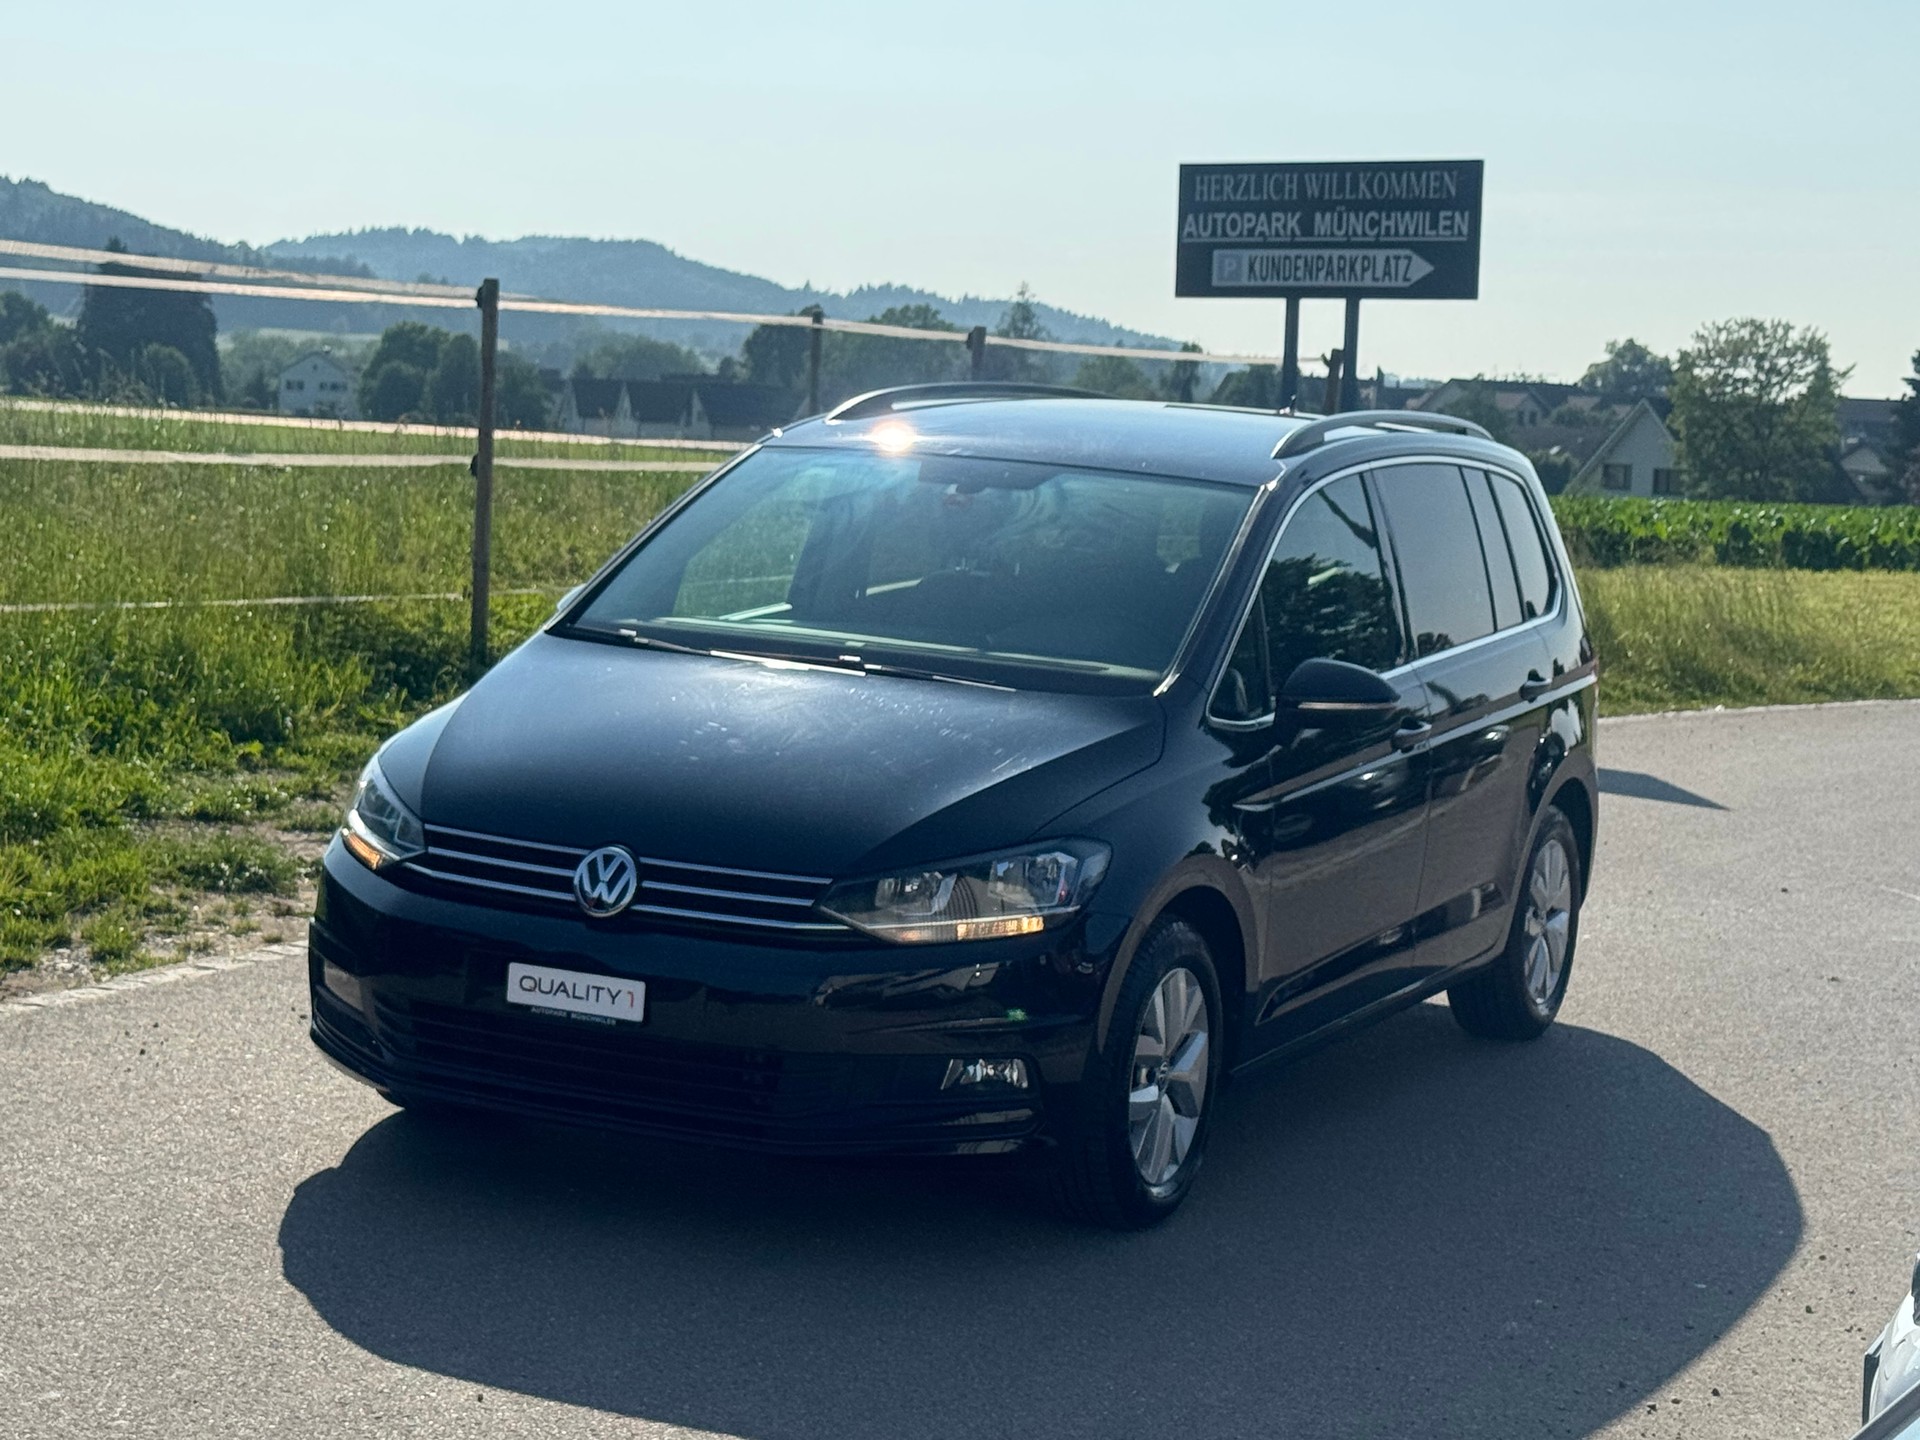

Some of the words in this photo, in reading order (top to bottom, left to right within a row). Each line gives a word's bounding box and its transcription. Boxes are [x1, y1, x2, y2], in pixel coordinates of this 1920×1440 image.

[1195, 173, 1298, 201] HERZLICH
[1304, 170, 1458, 200] WILLKOMMEN
[1182, 212, 1301, 237] AUTOPARK
[1314, 206, 1470, 236] MÜNCHWILEN
[1247, 254, 1413, 283] KUNDENPARKPLATZ
[519, 975, 622, 1005] QUALITY
